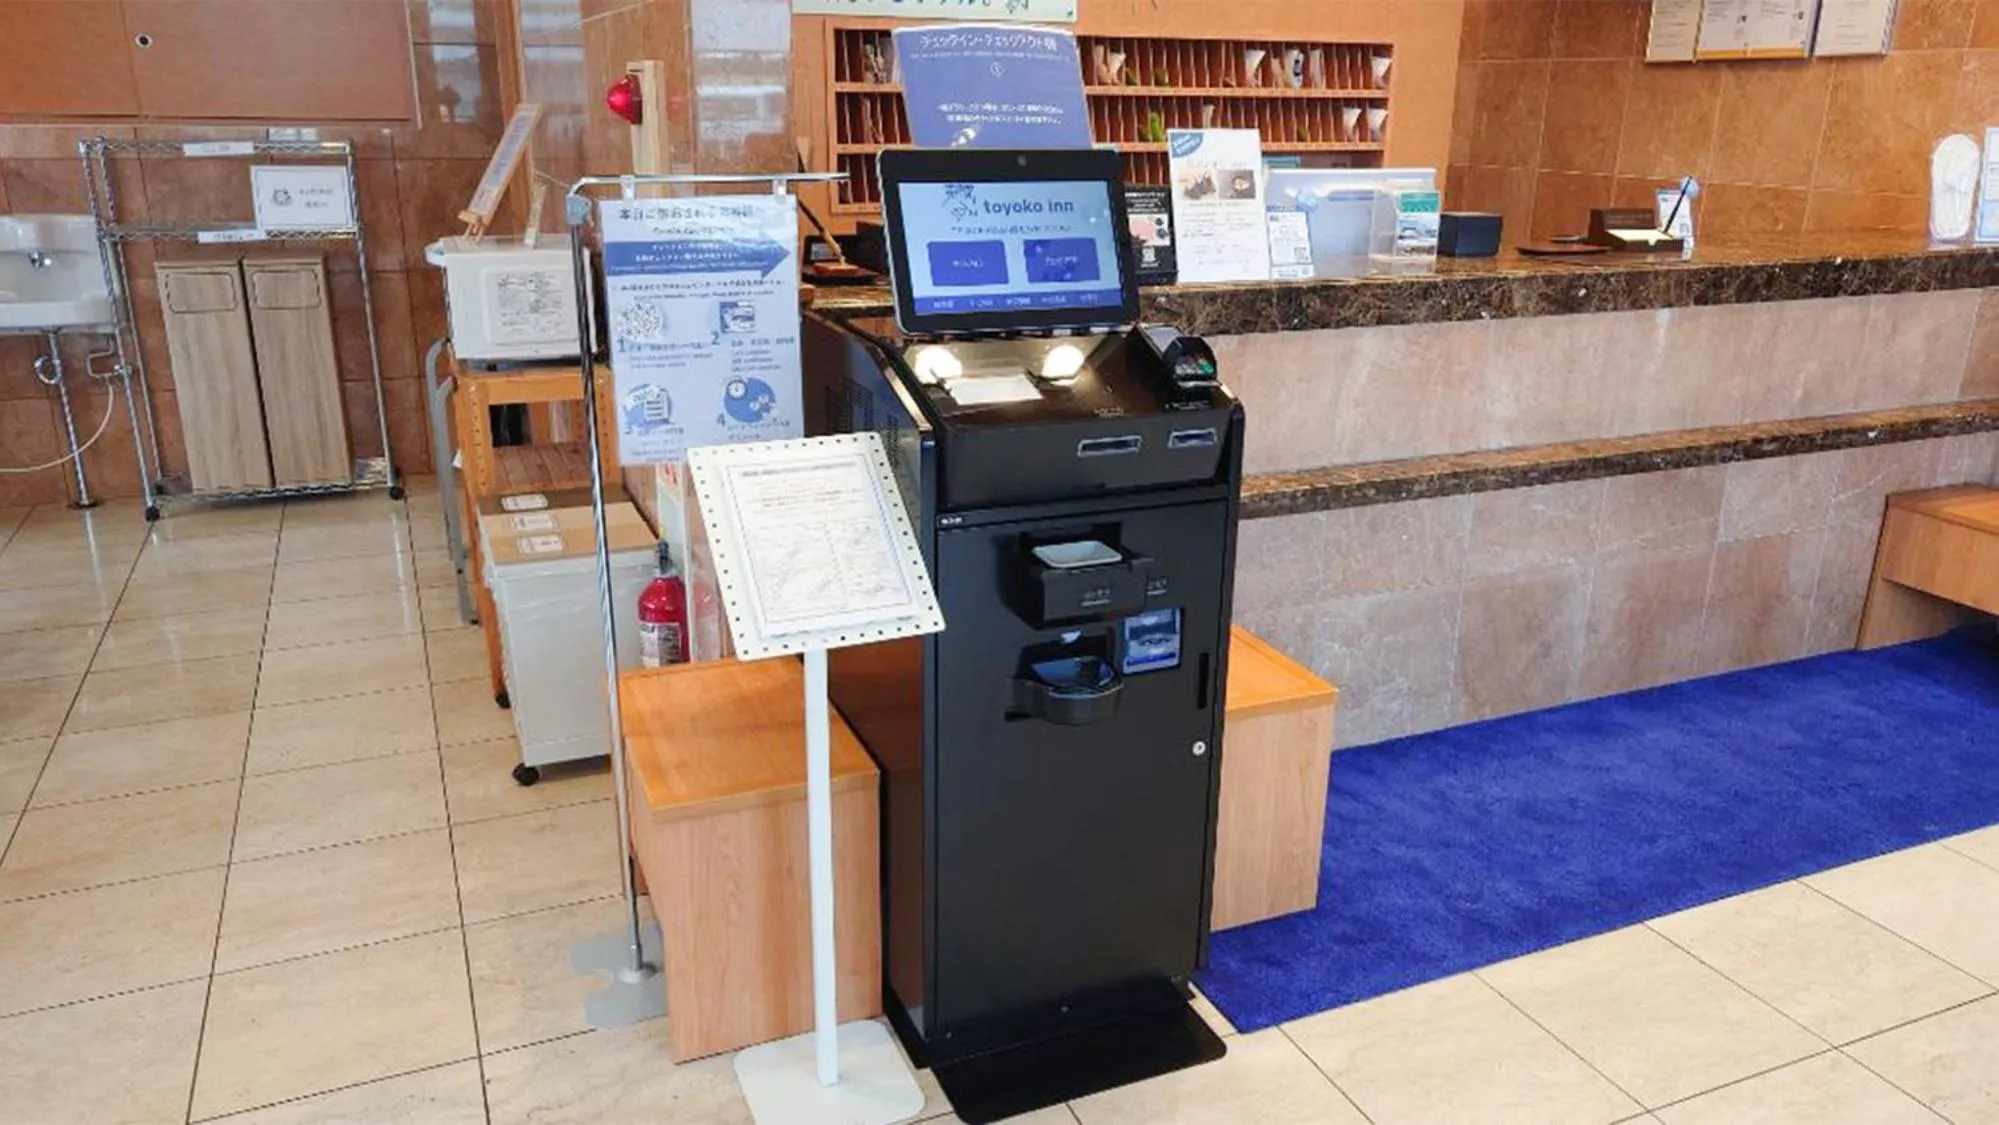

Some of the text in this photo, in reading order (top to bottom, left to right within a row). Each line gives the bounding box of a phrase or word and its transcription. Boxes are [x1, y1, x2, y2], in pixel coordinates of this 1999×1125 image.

[983, 198, 1074, 216] toyoko inn
[617, 337, 626, 353] 1
[711, 331, 720, 346] 2
